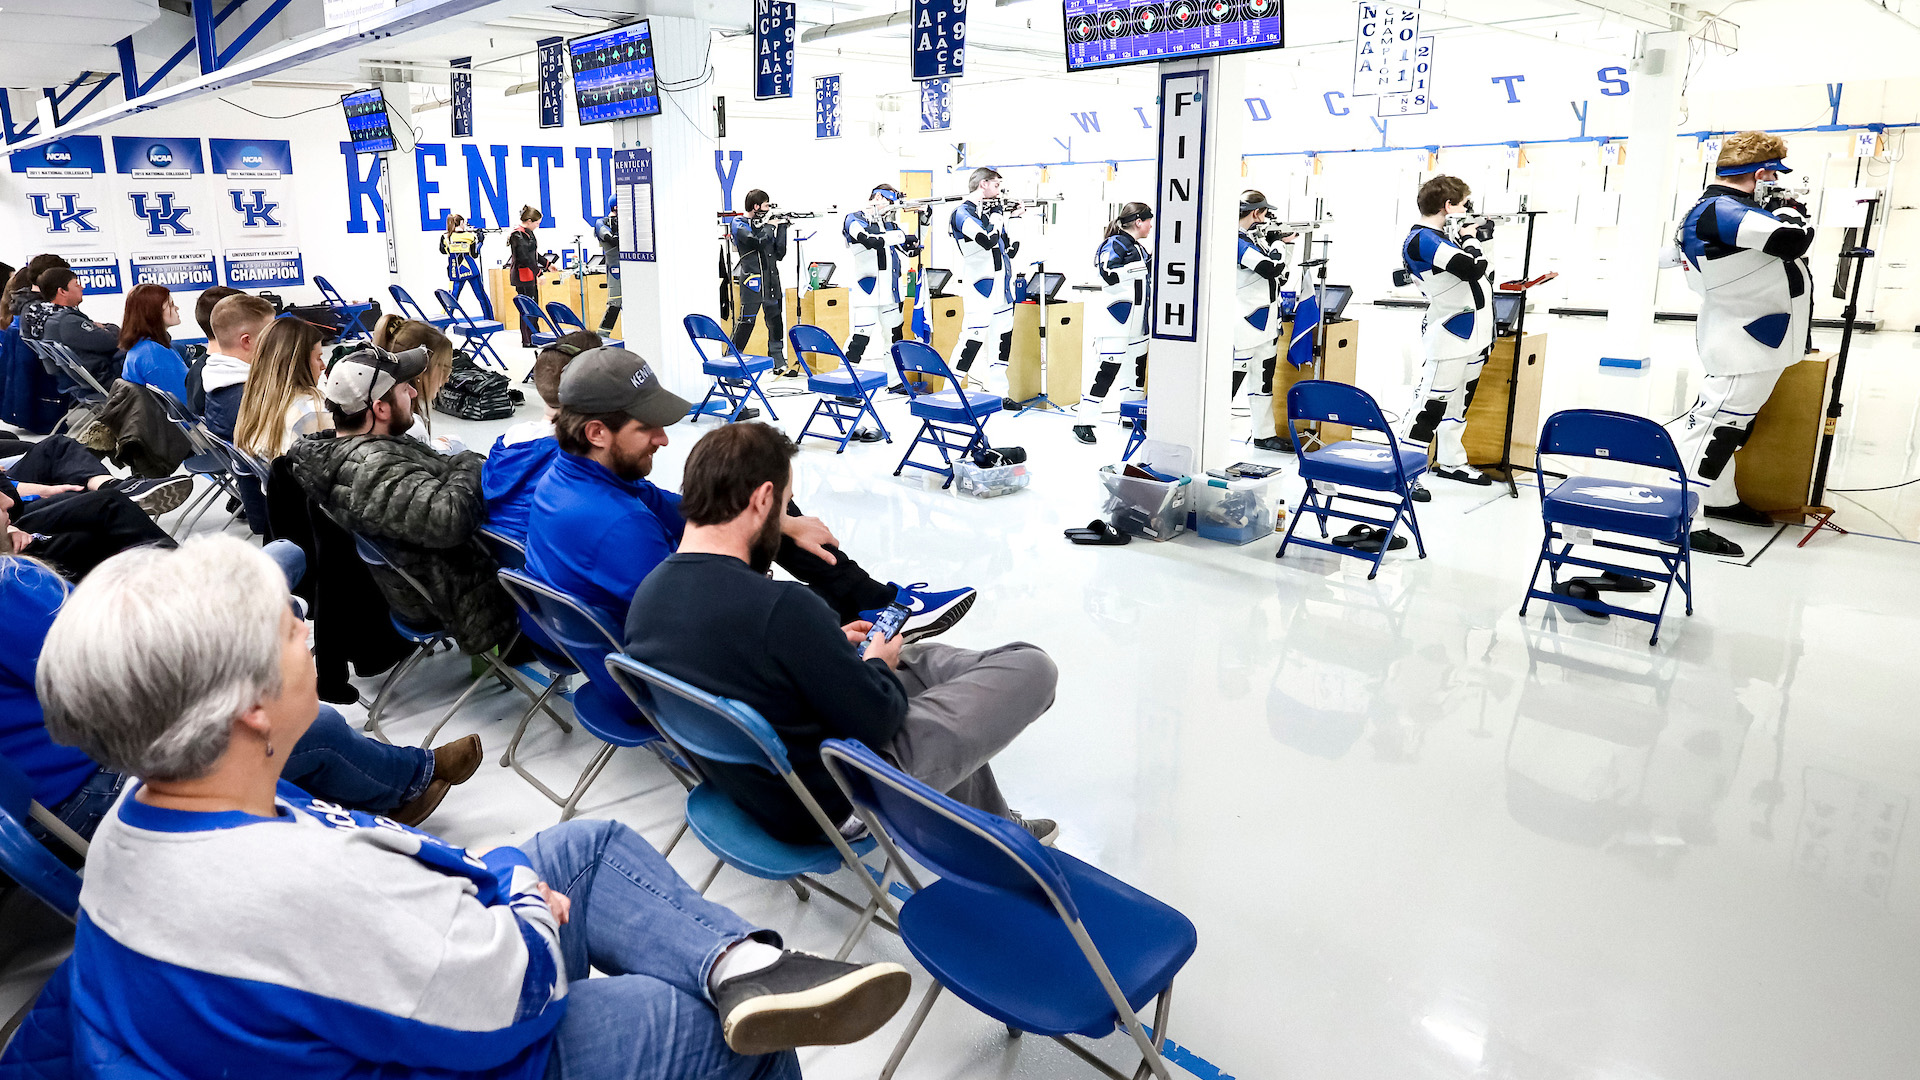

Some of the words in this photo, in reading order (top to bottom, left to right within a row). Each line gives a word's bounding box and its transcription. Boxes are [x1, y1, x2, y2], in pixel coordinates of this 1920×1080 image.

[759, 0, 772, 75] NCAA
[936, 10, 949, 75] PLACE
[1359, 5, 1377, 73] NCAA
[1379, 7, 1394, 86] CHAMPION
[1397, 9, 1415, 82] 2011
[541, 50, 551, 109] NCAA
[773, 40, 782, 95] PLACE
[1414, 46, 1429, 105] 2018
[461, 97, 469, 134] PLACE
[551, 81, 559, 123] PLACE
[816, 79, 824, 124] NCAA
[932, 92, 940, 129] PLACE
[46, 152, 72, 161] NCAA
[149, 154, 172, 162] NCAA
[242, 156, 263, 164] NCAA
[615, 159, 650, 170] KENTUCKY
[26, 193, 99, 234] UK
[128, 192, 194, 237] UK
[228, 189, 281, 228] UK
[382, 166, 395, 267] FINISH
[1164, 91, 1193, 326] FINISH
[95, 267, 112, 275] RIFLE
[230, 267, 299, 282] CHAMPION
[619, 252, 655, 261] WILDCATS
[137, 270, 213, 286] CHAMPION
